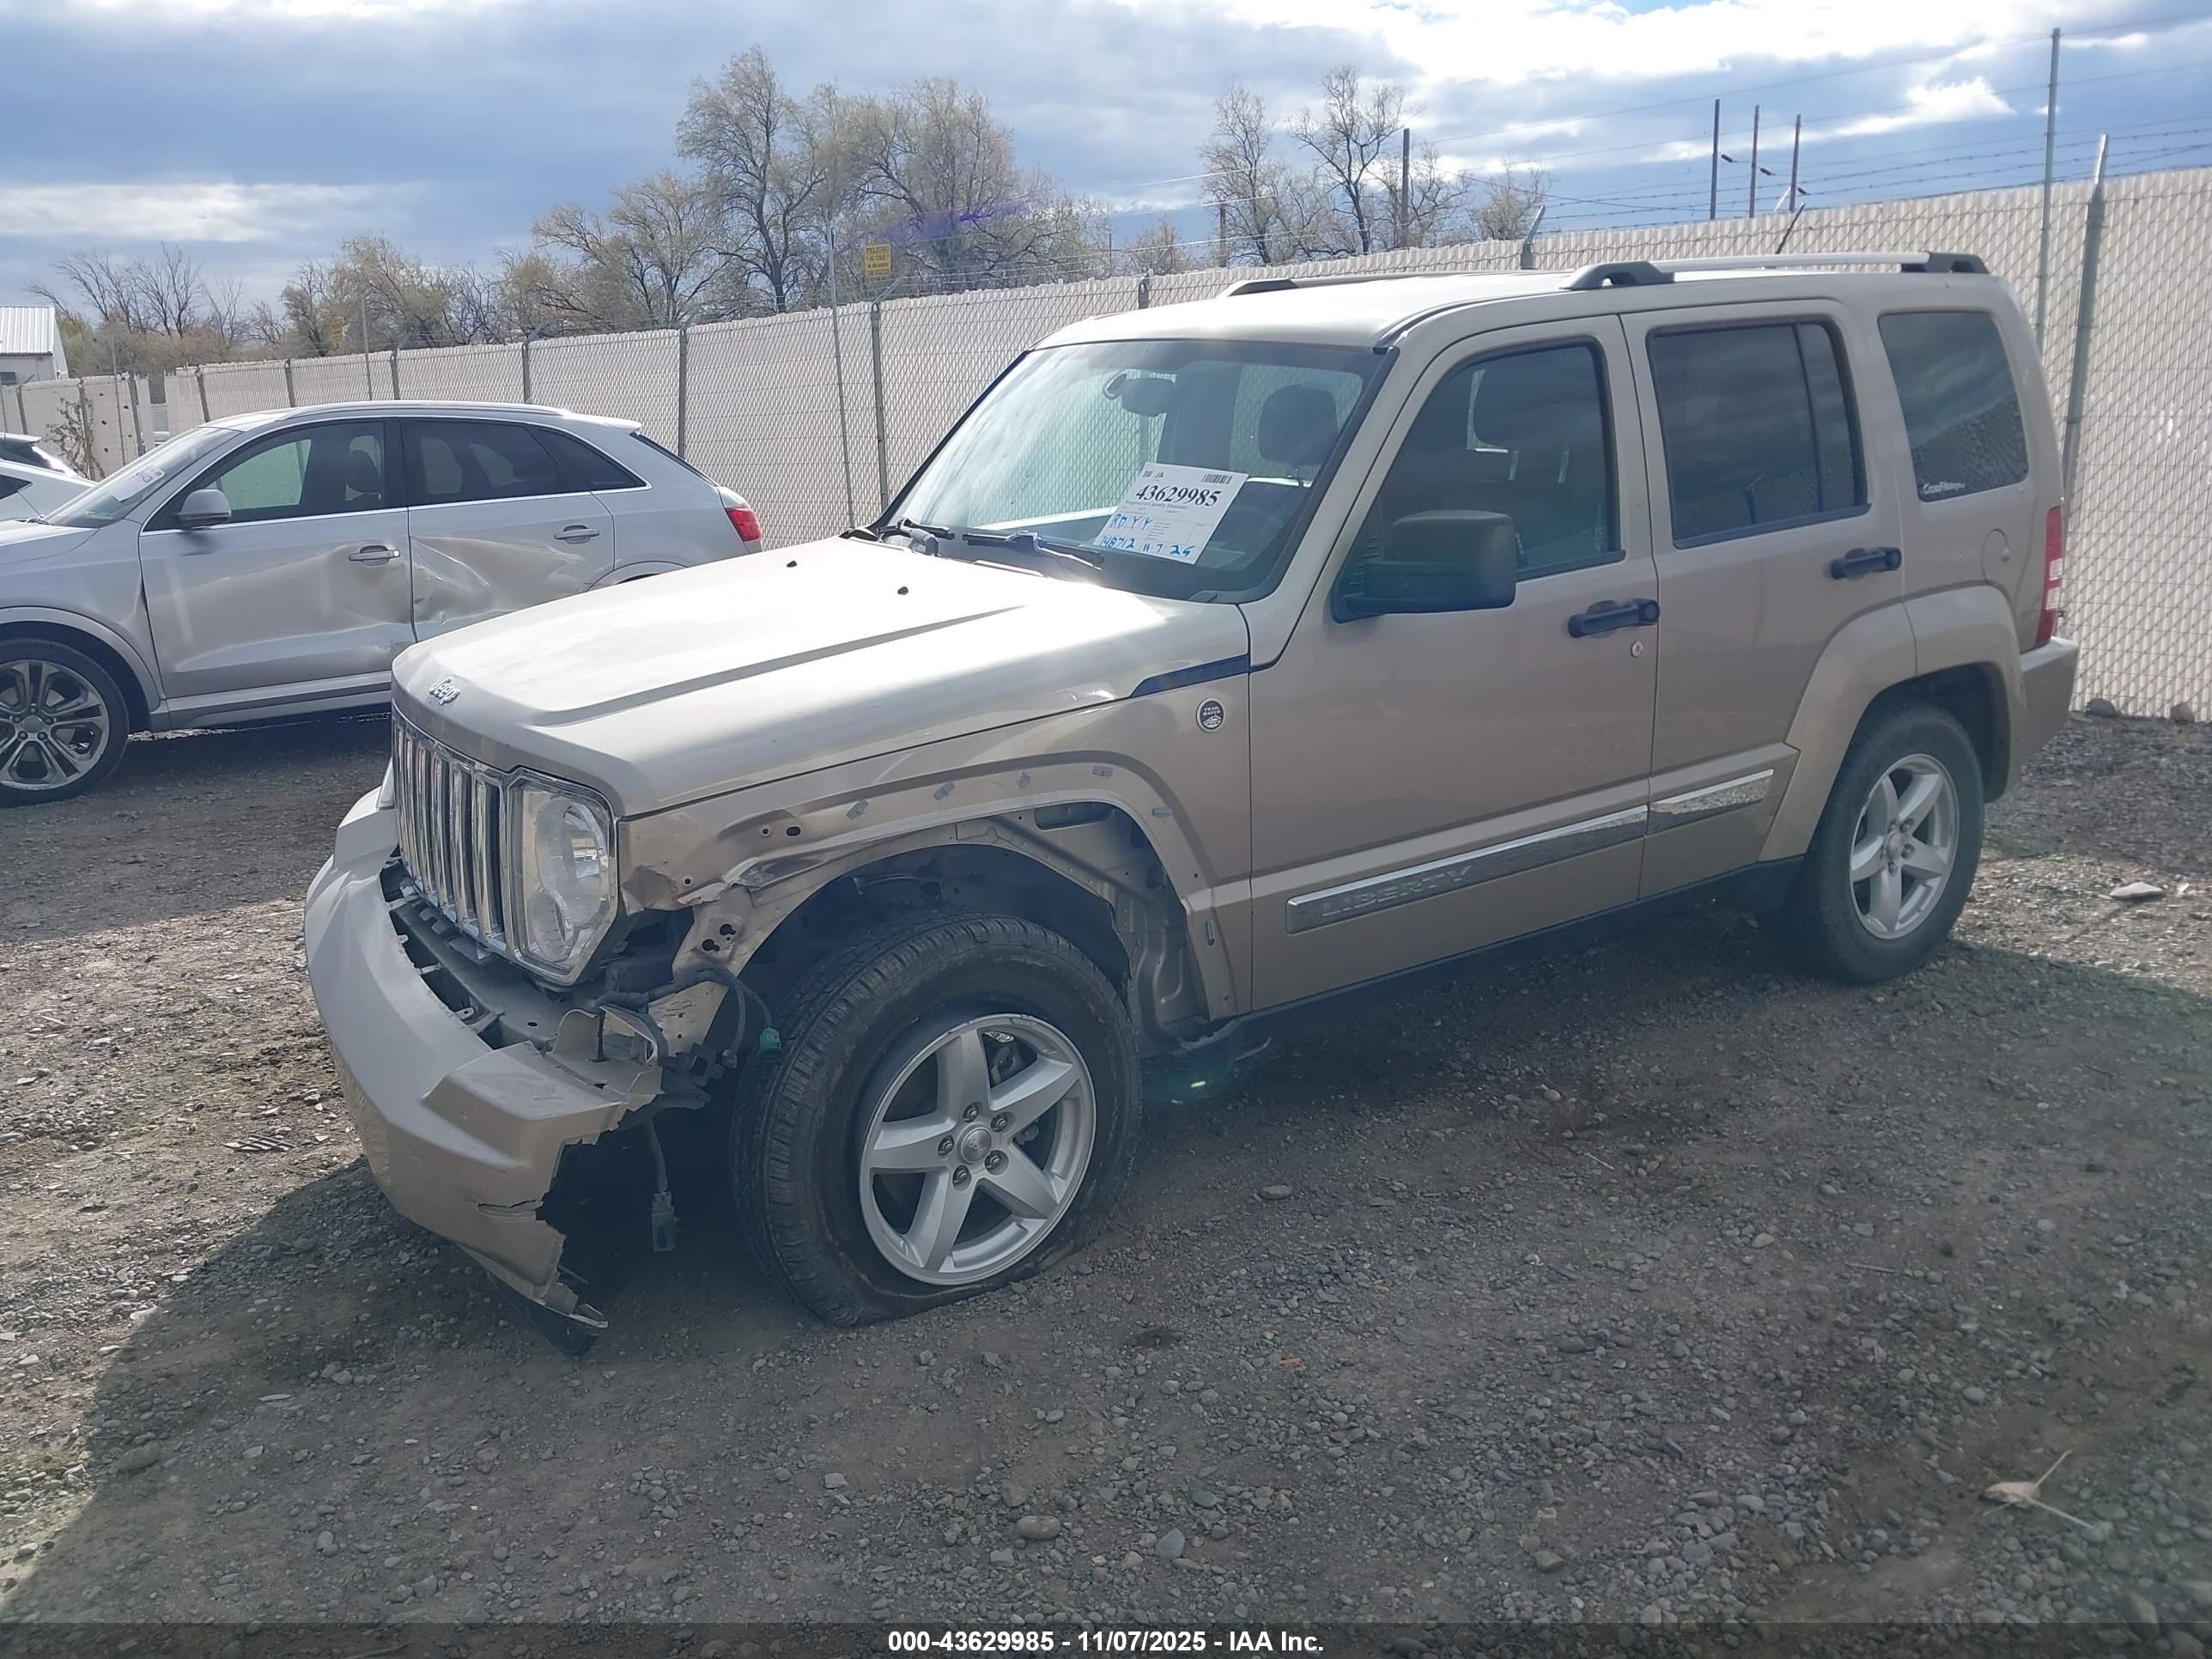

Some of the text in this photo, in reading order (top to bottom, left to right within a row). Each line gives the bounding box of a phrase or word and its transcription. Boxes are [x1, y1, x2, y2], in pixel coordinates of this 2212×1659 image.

[1135, 483, 1223, 507] 43629985
[428, 678, 461, 706] Jeep
[1322, 866, 1472, 917] LIBERTY
